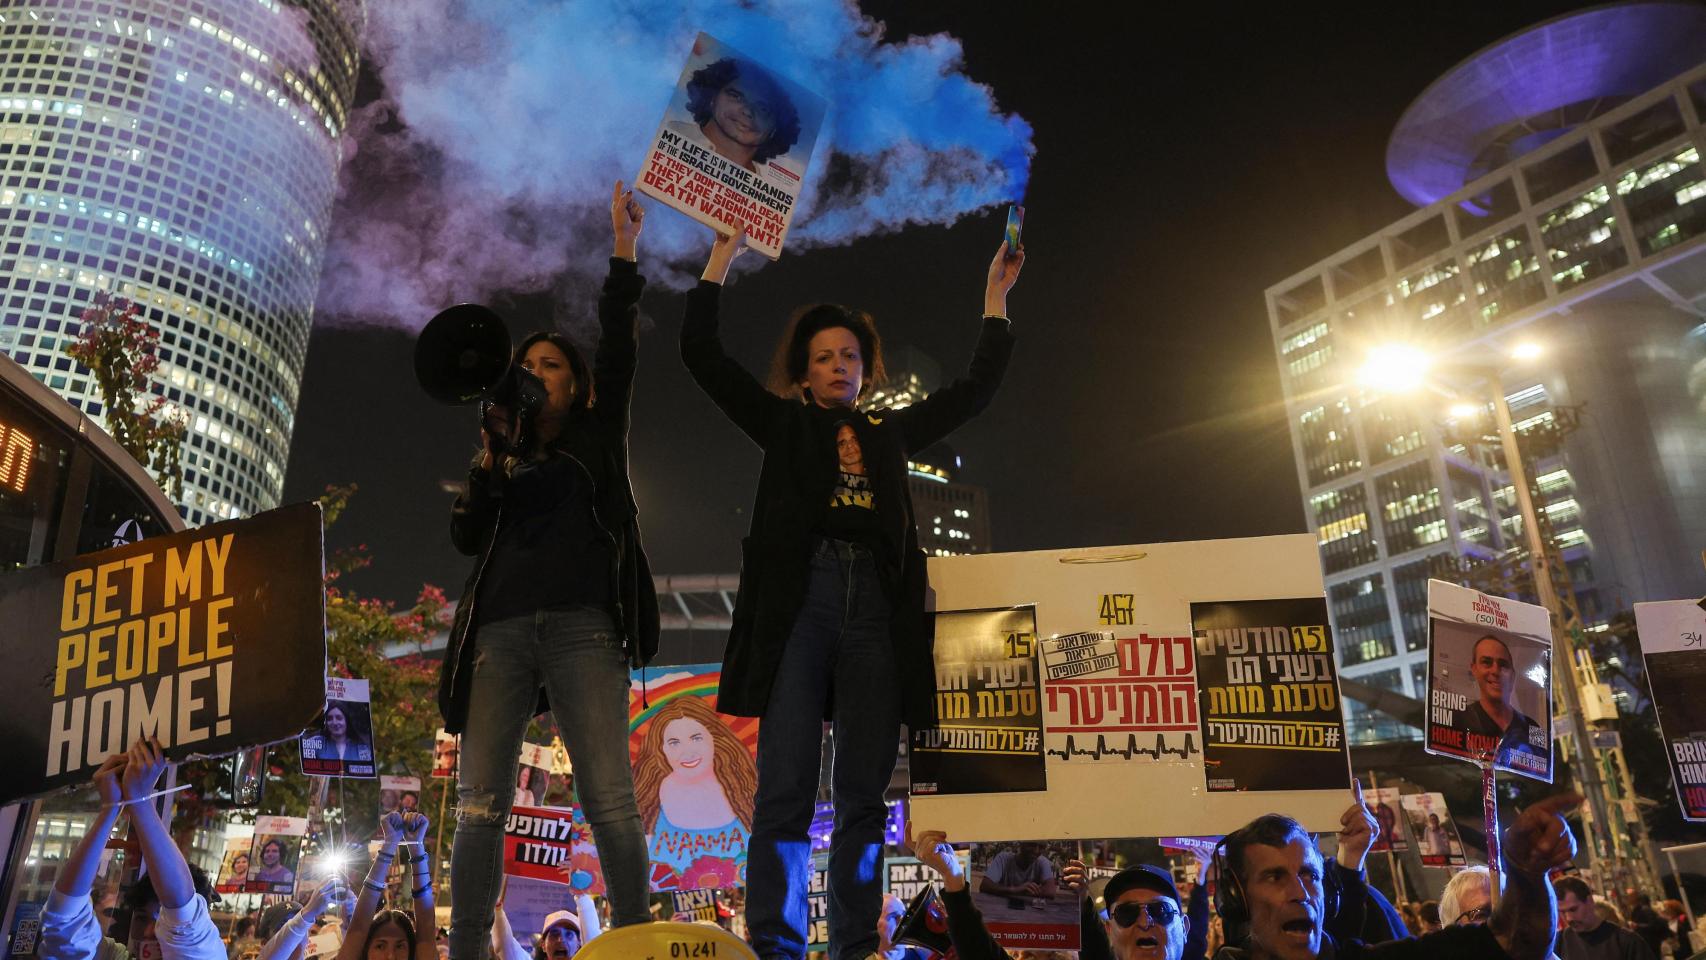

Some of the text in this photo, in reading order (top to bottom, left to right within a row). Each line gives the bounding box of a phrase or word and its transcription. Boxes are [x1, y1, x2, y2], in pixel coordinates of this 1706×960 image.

[657, 140, 667, 151] OF
[666, 144, 679, 158] THE
[679, 151, 720, 180] ISRAELI
[721, 173, 790, 215] GOVERNMENT
[661, 129, 682, 145] MY
[682, 140, 710, 162] LIFE
[710, 154, 720, 167] IS
[719, 159, 728, 171] IN
[729, 164, 752, 184] THE
[753, 177, 794, 206] HANDS
[643, 171, 697, 207] DEATH
[651, 160, 784, 237] THEY ARE SIGNING MY
[653, 151, 785, 226] IF THEY DON'T SIGN A DEAL
[60, 533, 234, 632] GET MY
[1100, 594, 1134, 625] 467
[1475, 613, 1495, 625] (50)
[53, 597, 234, 697] PEOPLE
[1006, 632, 1030, 658] 15
[1053, 637, 1080, 650] ואנש
[1064, 646, 1098, 662] בריאות
[1117, 633, 1194, 677] כולם
[1293, 626, 1322, 653] 15
[1052, 655, 1115, 679] למען החטופים
[1226, 654, 1332, 684] בשבי הם
[937, 688, 1036, 719] סכנת מוו
[1045, 683, 1198, 726] הומניטרי
[1208, 683, 1335, 714] סכנת מוות
[1432, 689, 1467, 712] BRING
[45, 660, 233, 777] HOME!
[1431, 706, 1453, 727] HIM
[915, 728, 1039, 751] #כולםהומניטרי
[1208, 722, 1340, 748] #כולםהומניטרי
[1431, 726, 1462, 748] HOME
[654, 827, 745, 860] NAAMA
[890, 865, 918, 882] את
